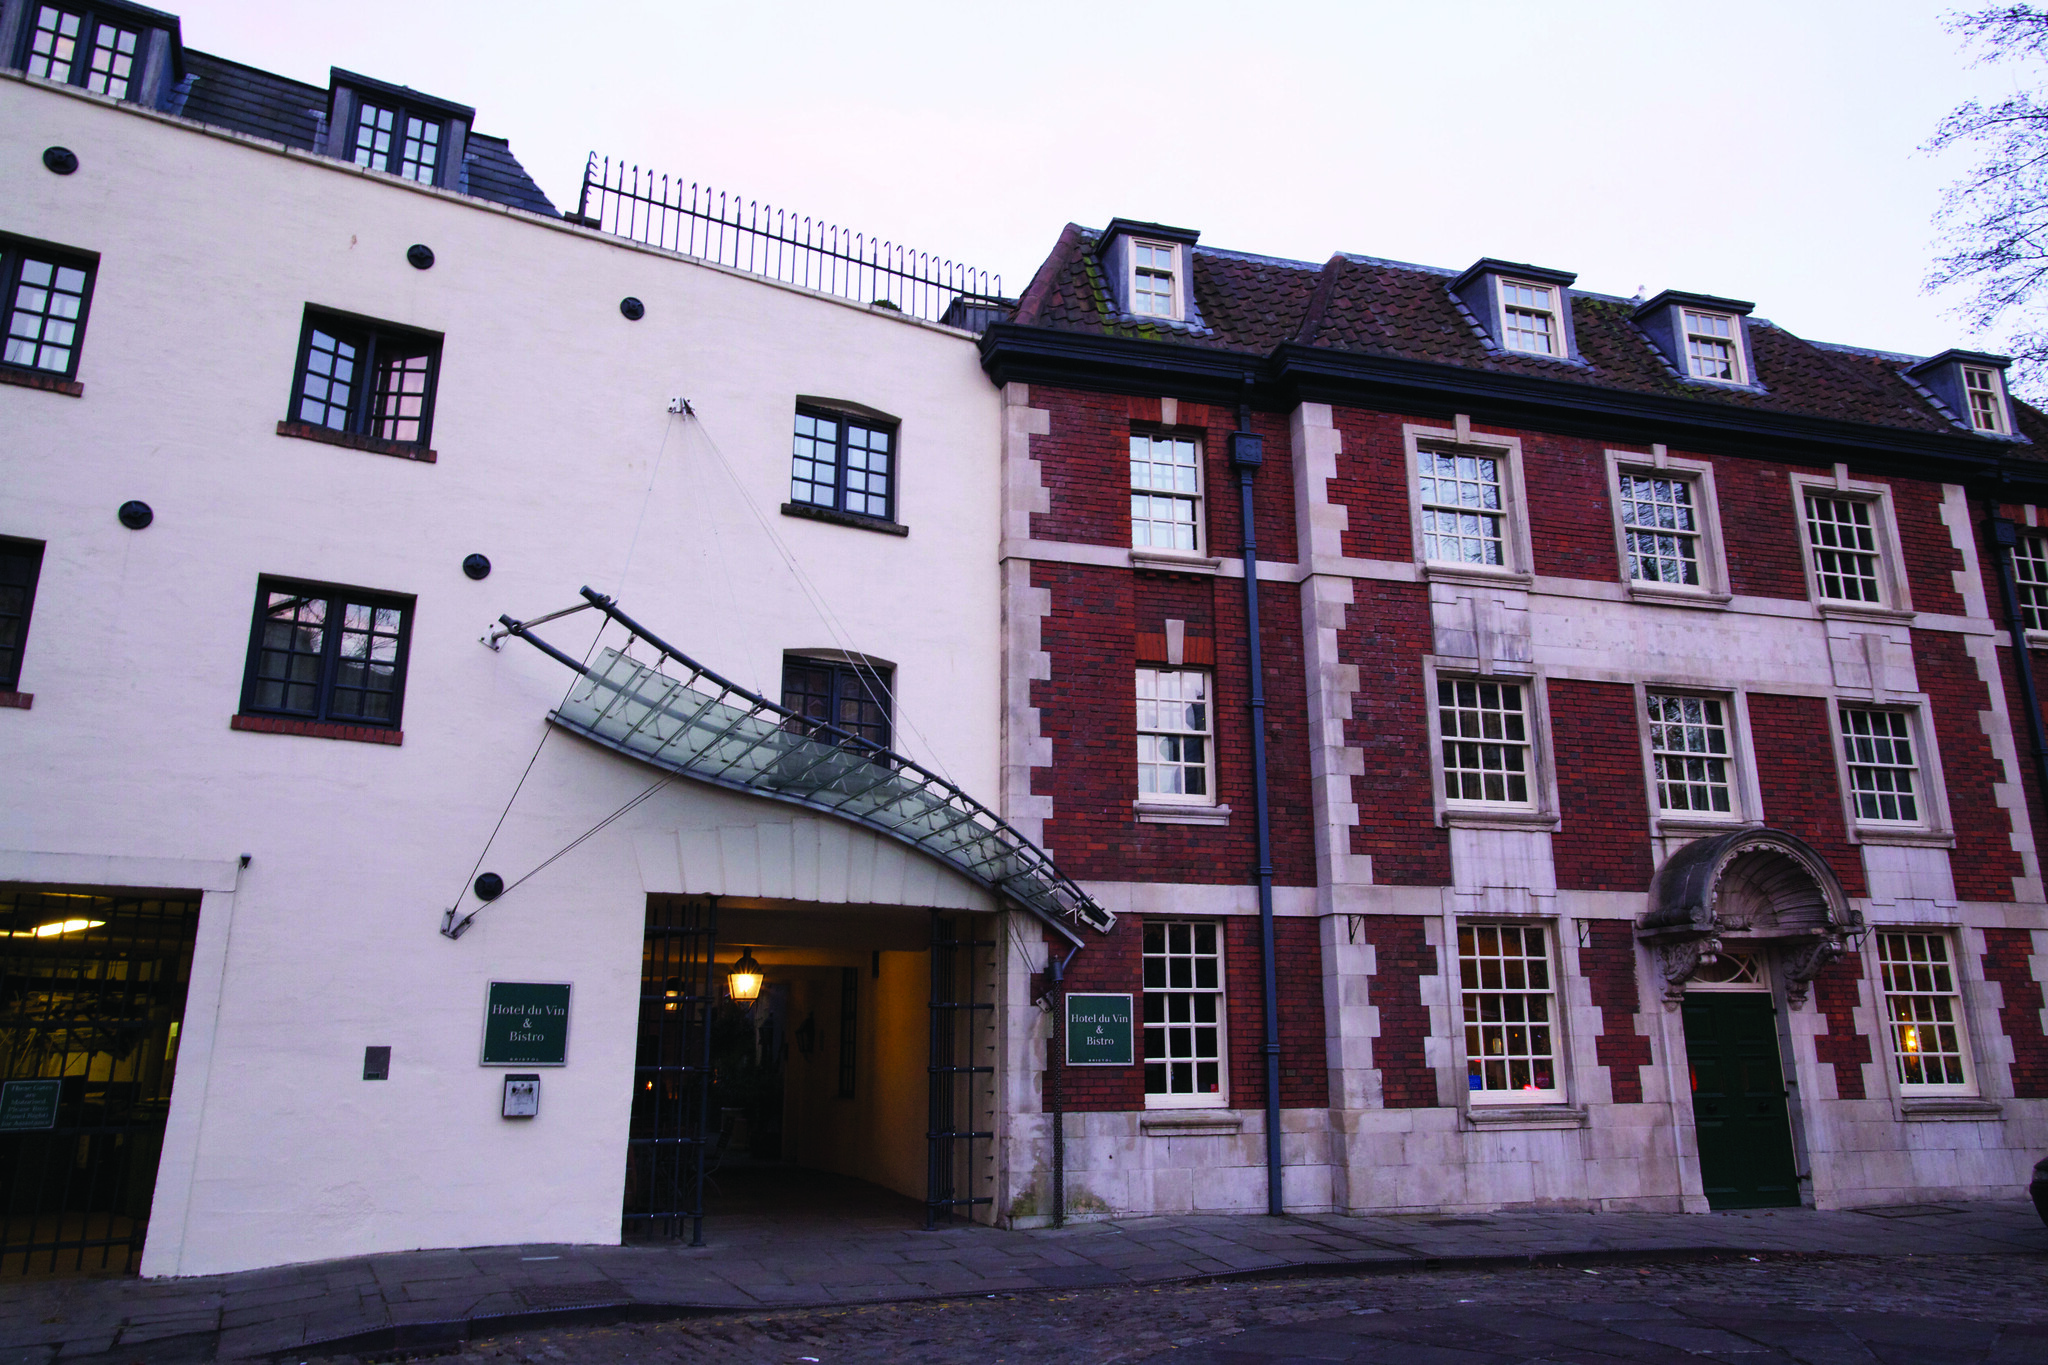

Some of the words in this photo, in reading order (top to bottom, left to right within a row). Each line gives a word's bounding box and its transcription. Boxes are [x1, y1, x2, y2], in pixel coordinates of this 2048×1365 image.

[492, 1003, 525, 1015] Hotel
[527, 1004, 542, 1016] du
[545, 1004, 565, 1016] Vin
[522, 1017, 533, 1029] &
[1071, 1013, 1097, 1023] Hotel
[1098, 1013, 1111, 1023] du
[1112, 1013, 1128, 1023] Vin
[1095, 1024, 1105, 1034] &
[509, 1031, 545, 1042] Bistro
[1086, 1036, 1115, 1046] Bistro
